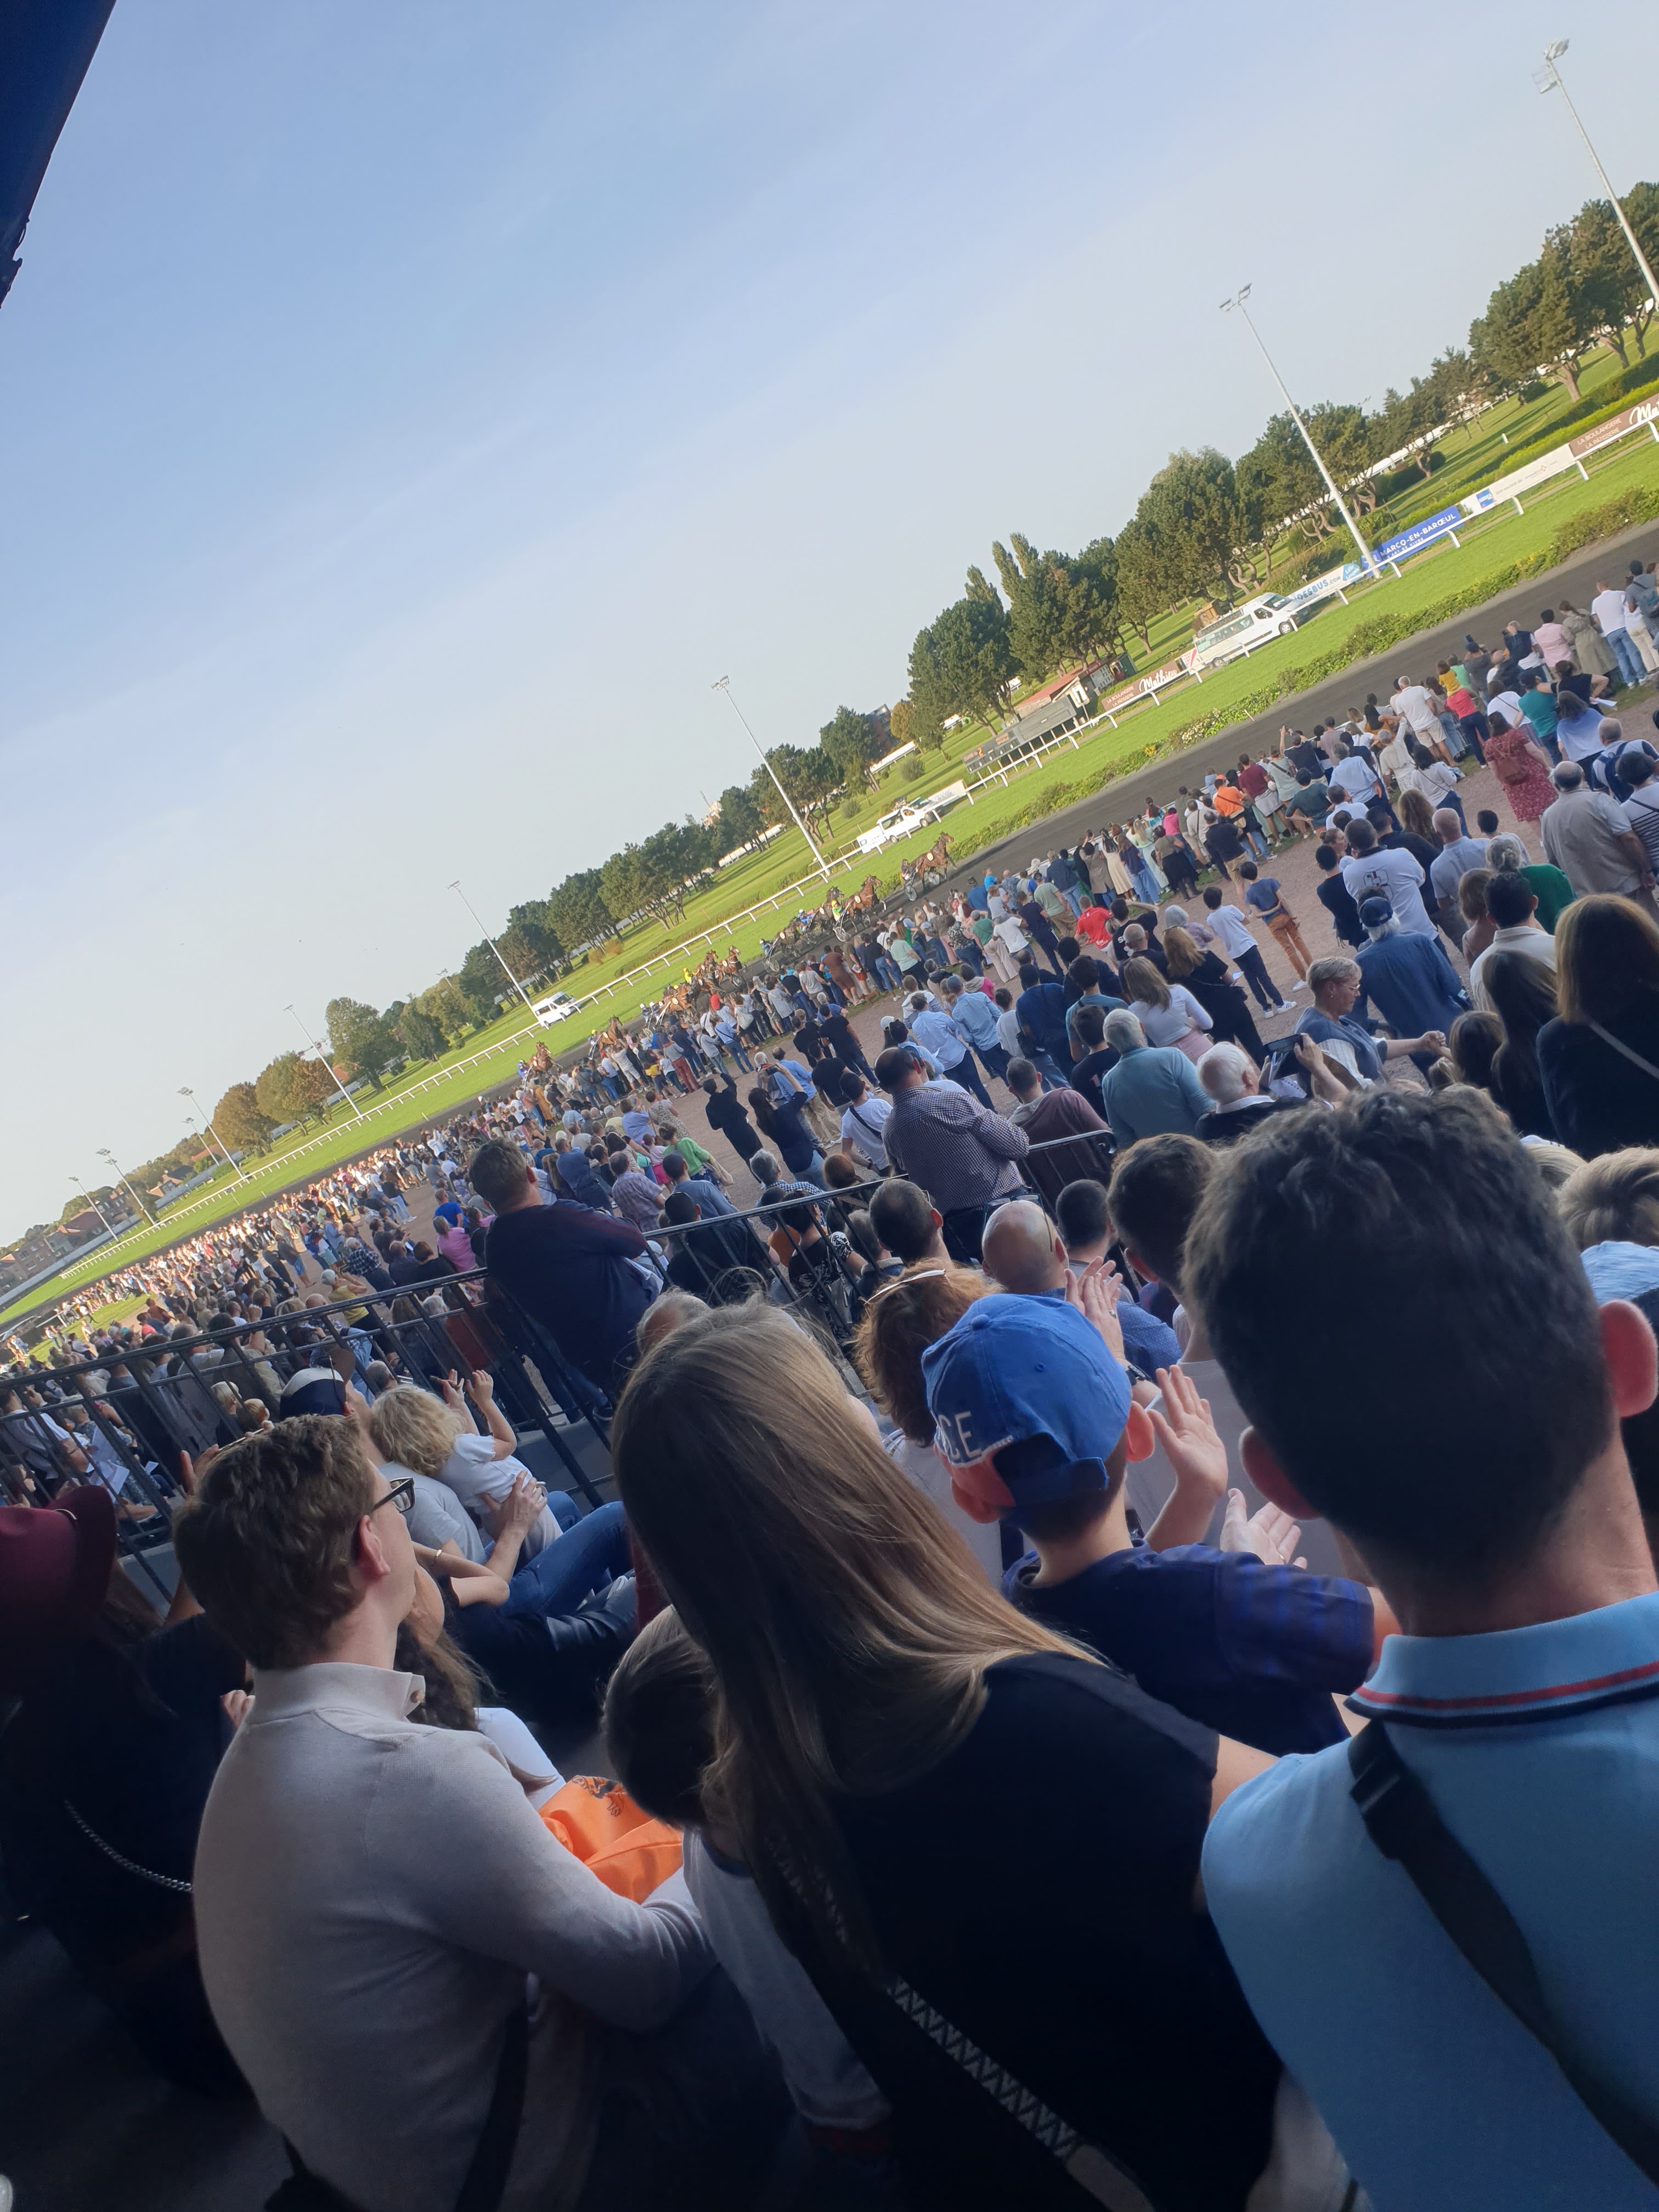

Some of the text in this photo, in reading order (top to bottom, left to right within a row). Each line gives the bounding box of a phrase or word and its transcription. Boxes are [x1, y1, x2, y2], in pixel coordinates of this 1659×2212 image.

[1584, 417, 1622, 441] BOULANGERIE
[1380, 513, 1457, 556] MARCQ-EN-BARŒUL
[1138, 669, 1177, 692] Mathieu
[938, 1411, 982, 1459] CE
